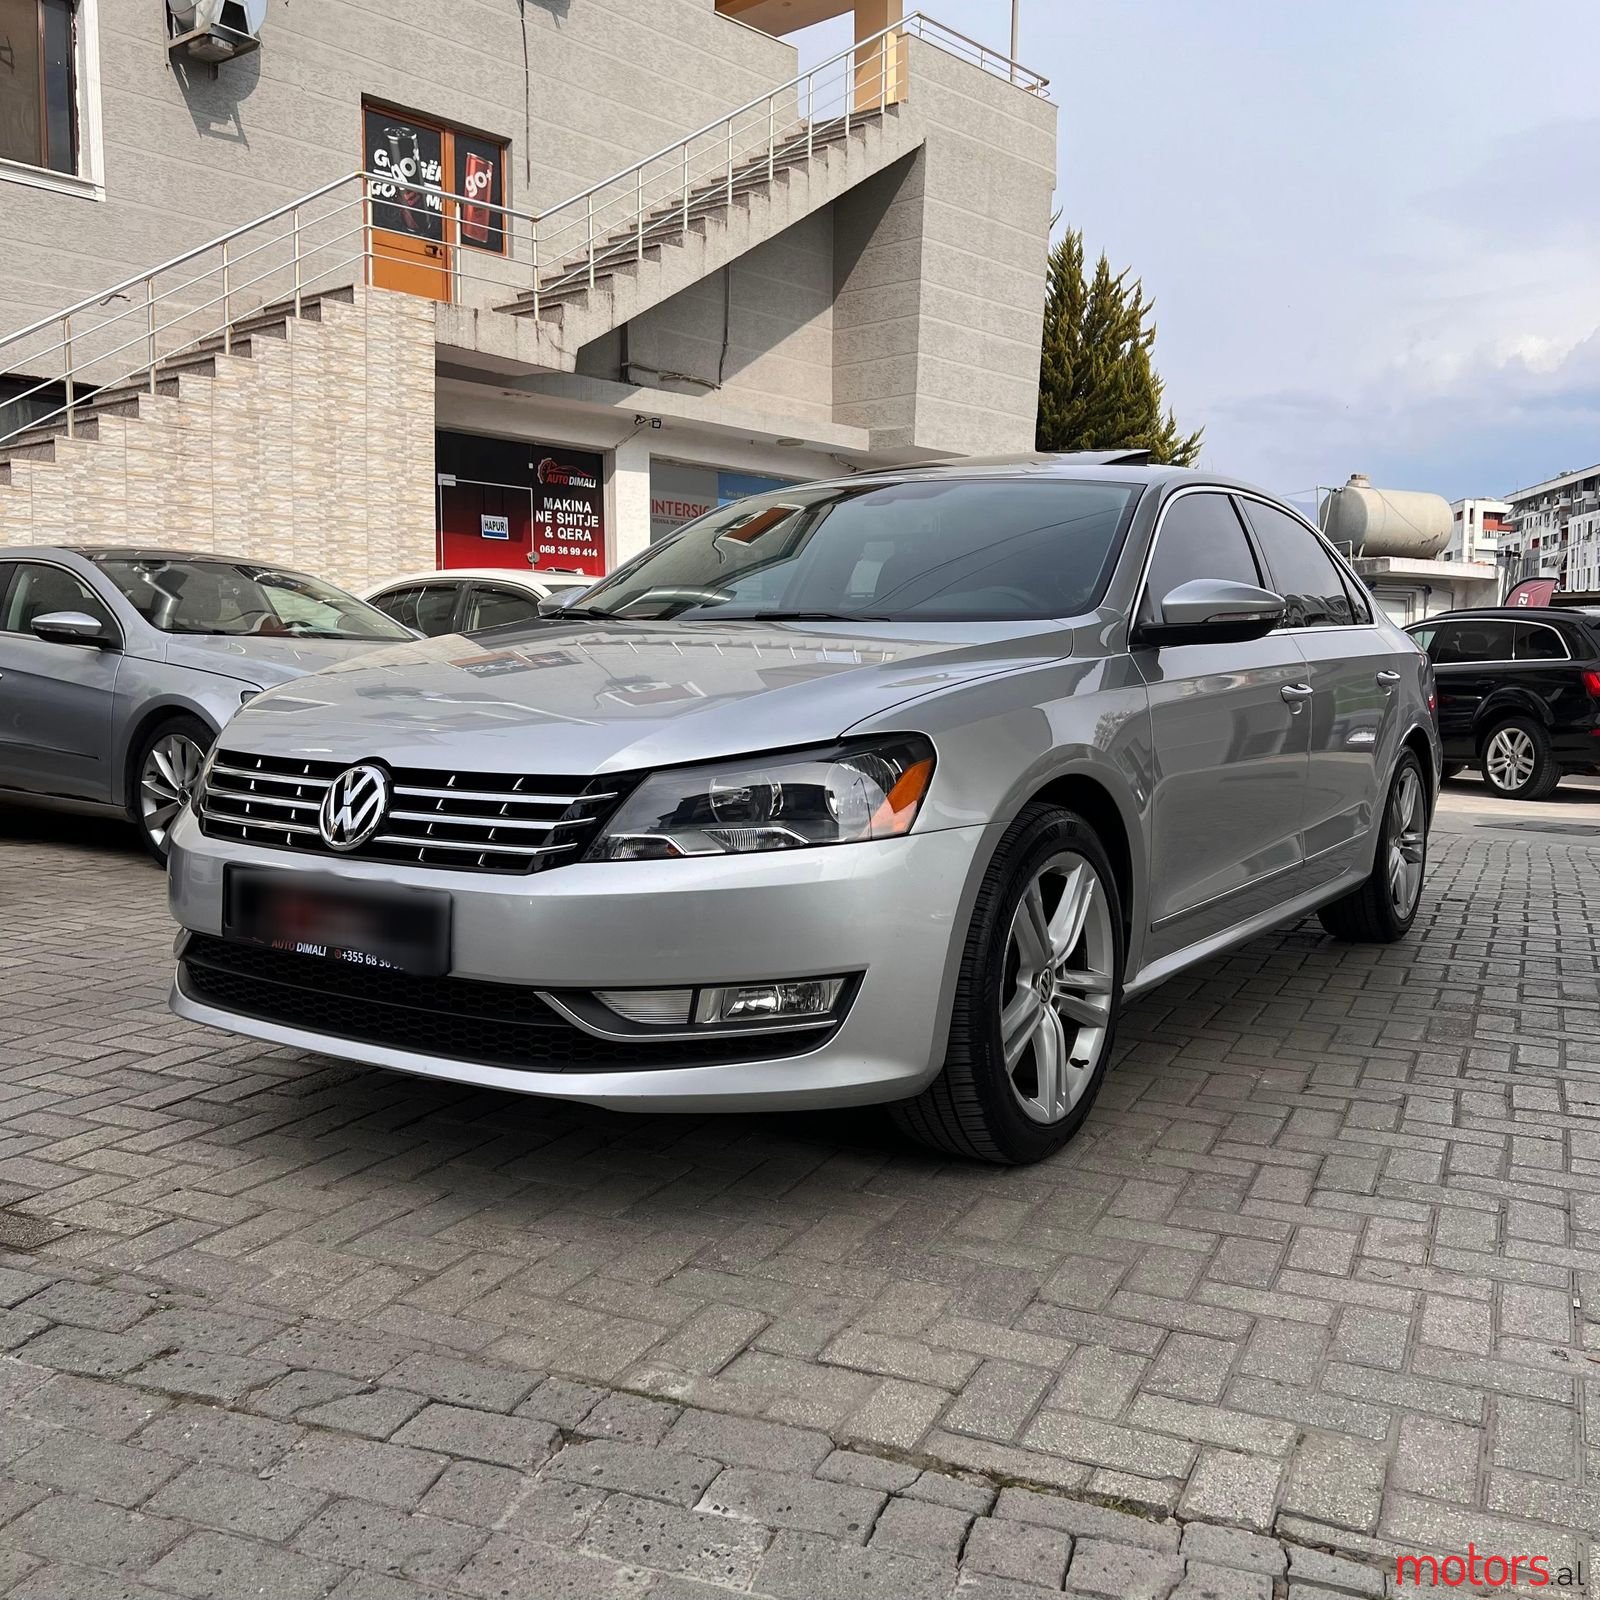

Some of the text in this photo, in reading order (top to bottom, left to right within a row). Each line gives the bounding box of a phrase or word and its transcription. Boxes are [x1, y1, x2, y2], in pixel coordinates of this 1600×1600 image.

[543, 497, 592, 514] MAKINA
[484, 520, 505, 532] HAPUR
[535, 510, 599, 527] NE SHITJE
[544, 526, 592, 542] & QERA
[540, 545, 598, 557] 068 36 99 414
[296, 942, 327, 957] DIMALI
[342, 950, 364, 964] +355
[365, 954, 377, 966] 68
